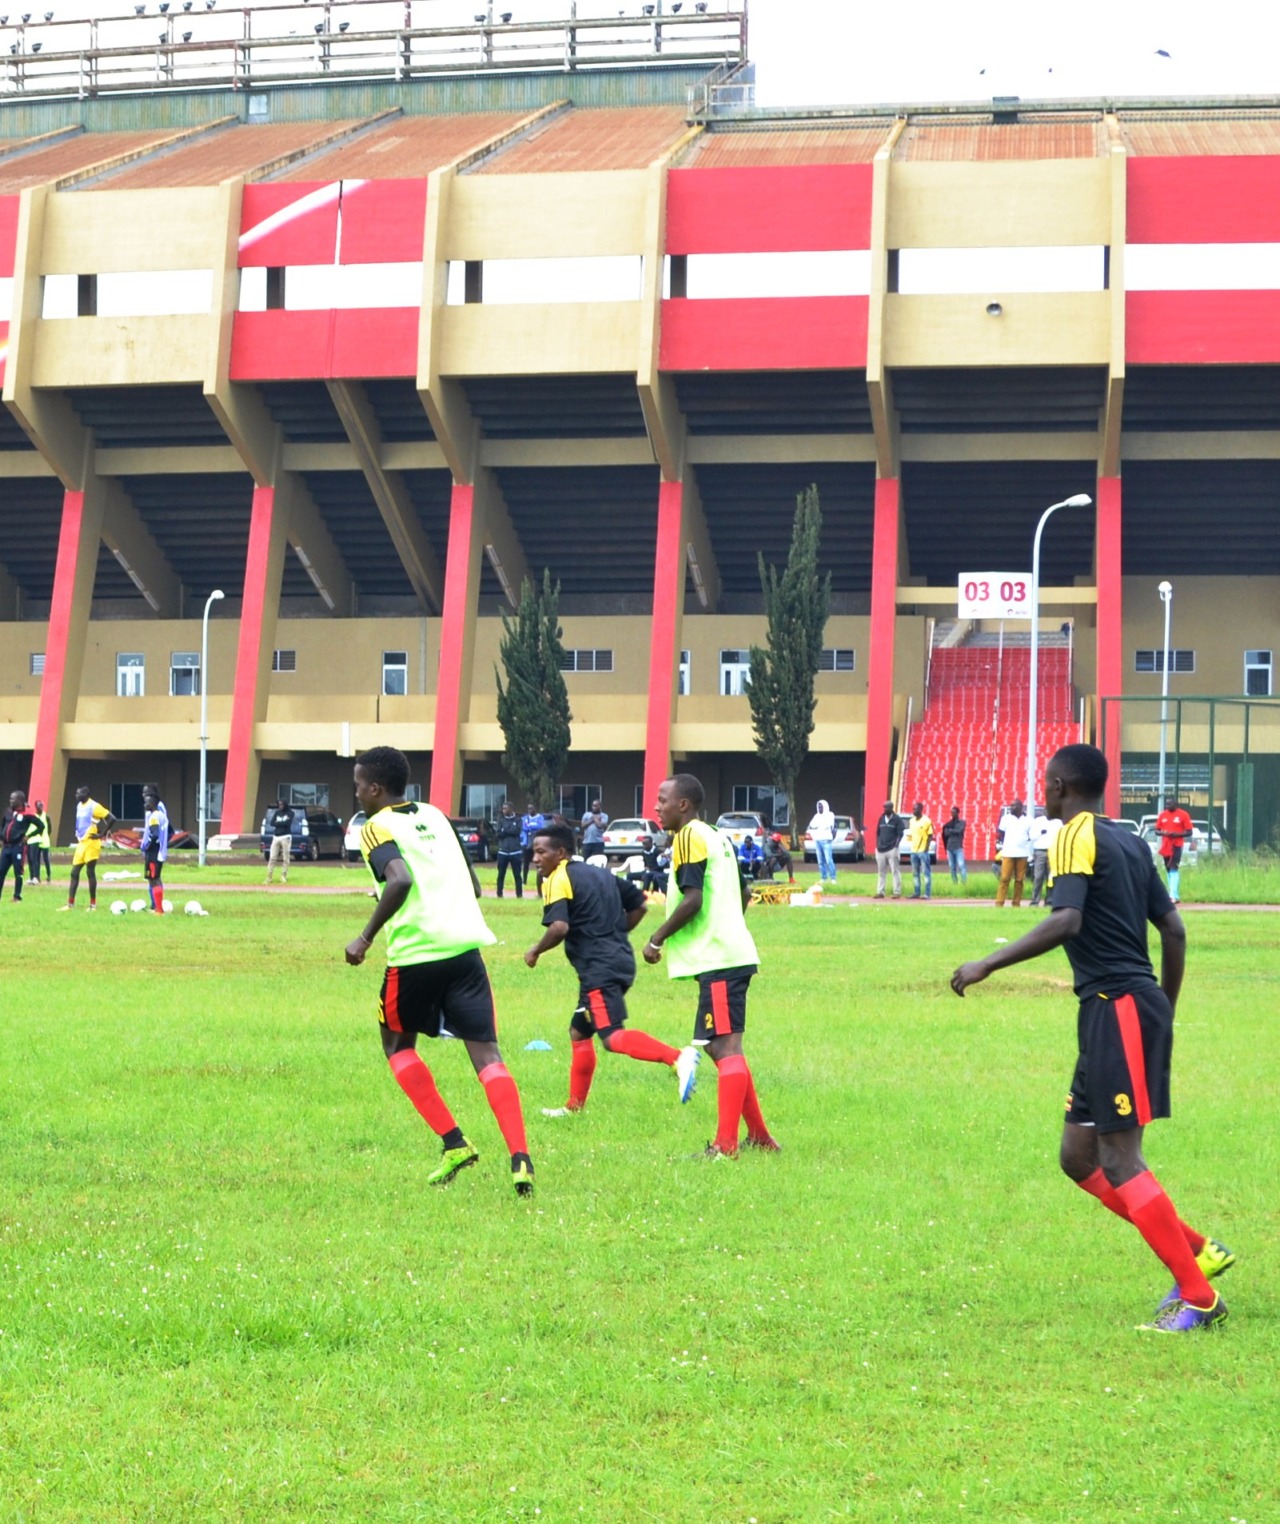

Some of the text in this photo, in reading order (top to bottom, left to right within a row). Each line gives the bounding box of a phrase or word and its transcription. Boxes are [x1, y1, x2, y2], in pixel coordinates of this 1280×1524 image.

[964, 581, 990, 602] 03
[1000, 581, 1026, 602] 03
[705, 1012, 714, 1029] 2
[1114, 1093, 1132, 1116] 3
